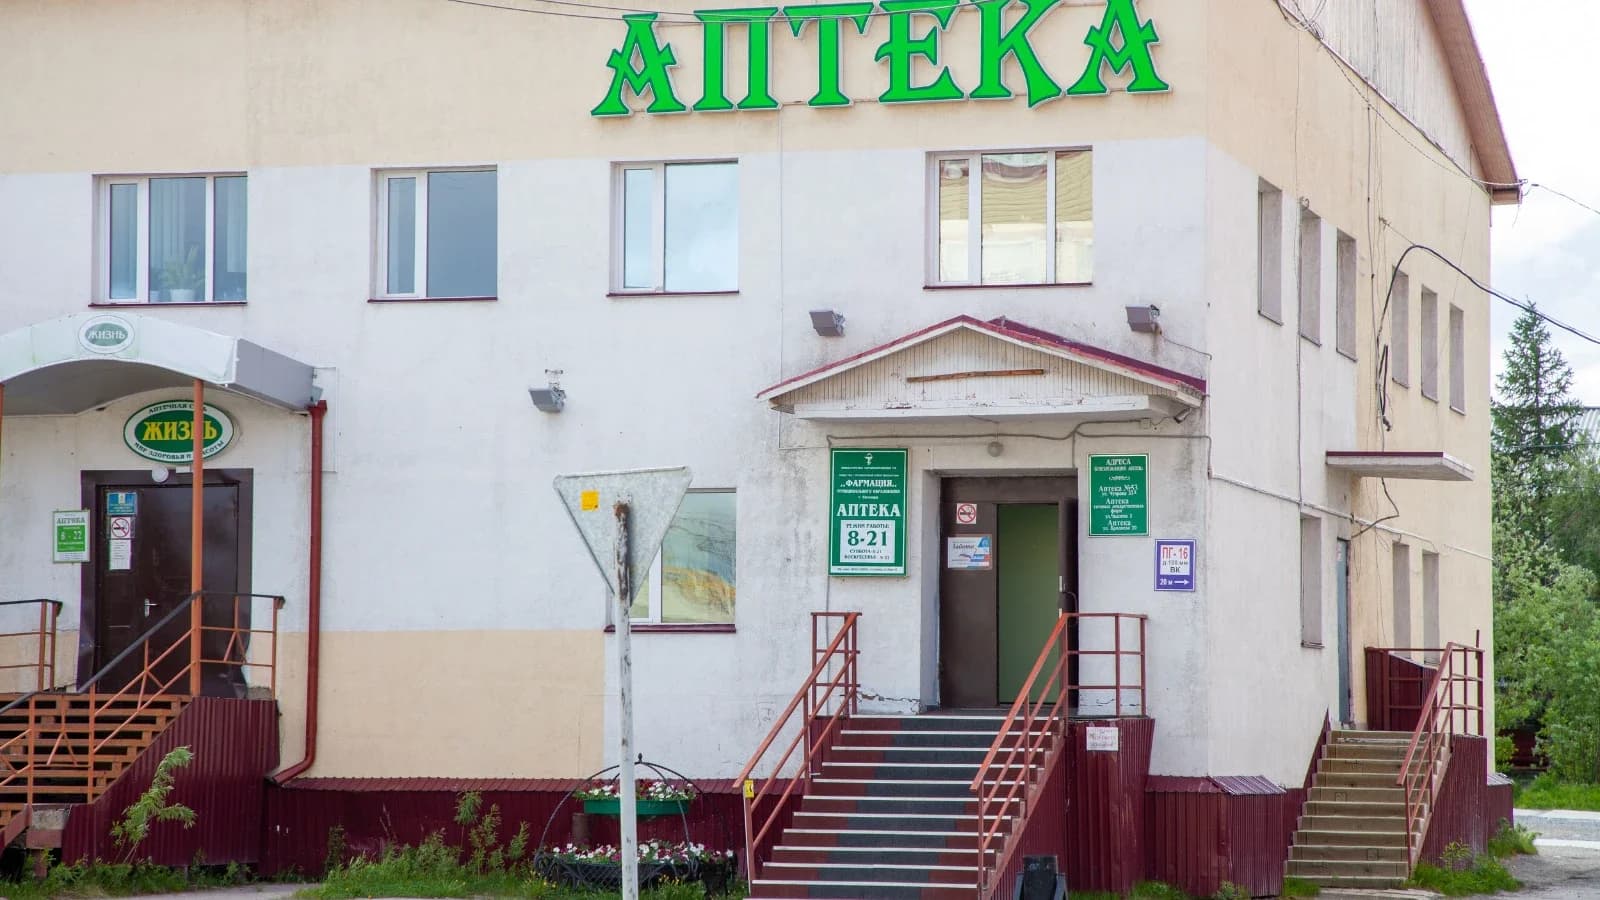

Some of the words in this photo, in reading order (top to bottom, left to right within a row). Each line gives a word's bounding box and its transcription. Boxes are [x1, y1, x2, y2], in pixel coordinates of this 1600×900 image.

[590, 0, 1170, 117] АПТЕКА
[88, 330, 126, 340] ЖИЗНЬ
[142, 421, 218, 441] ЖИЗЬ
[1105, 458, 1132, 466] АДРЕСА
[836, 503, 901, 517] АПТЕКА
[847, 530, 888, 546] 8-21
